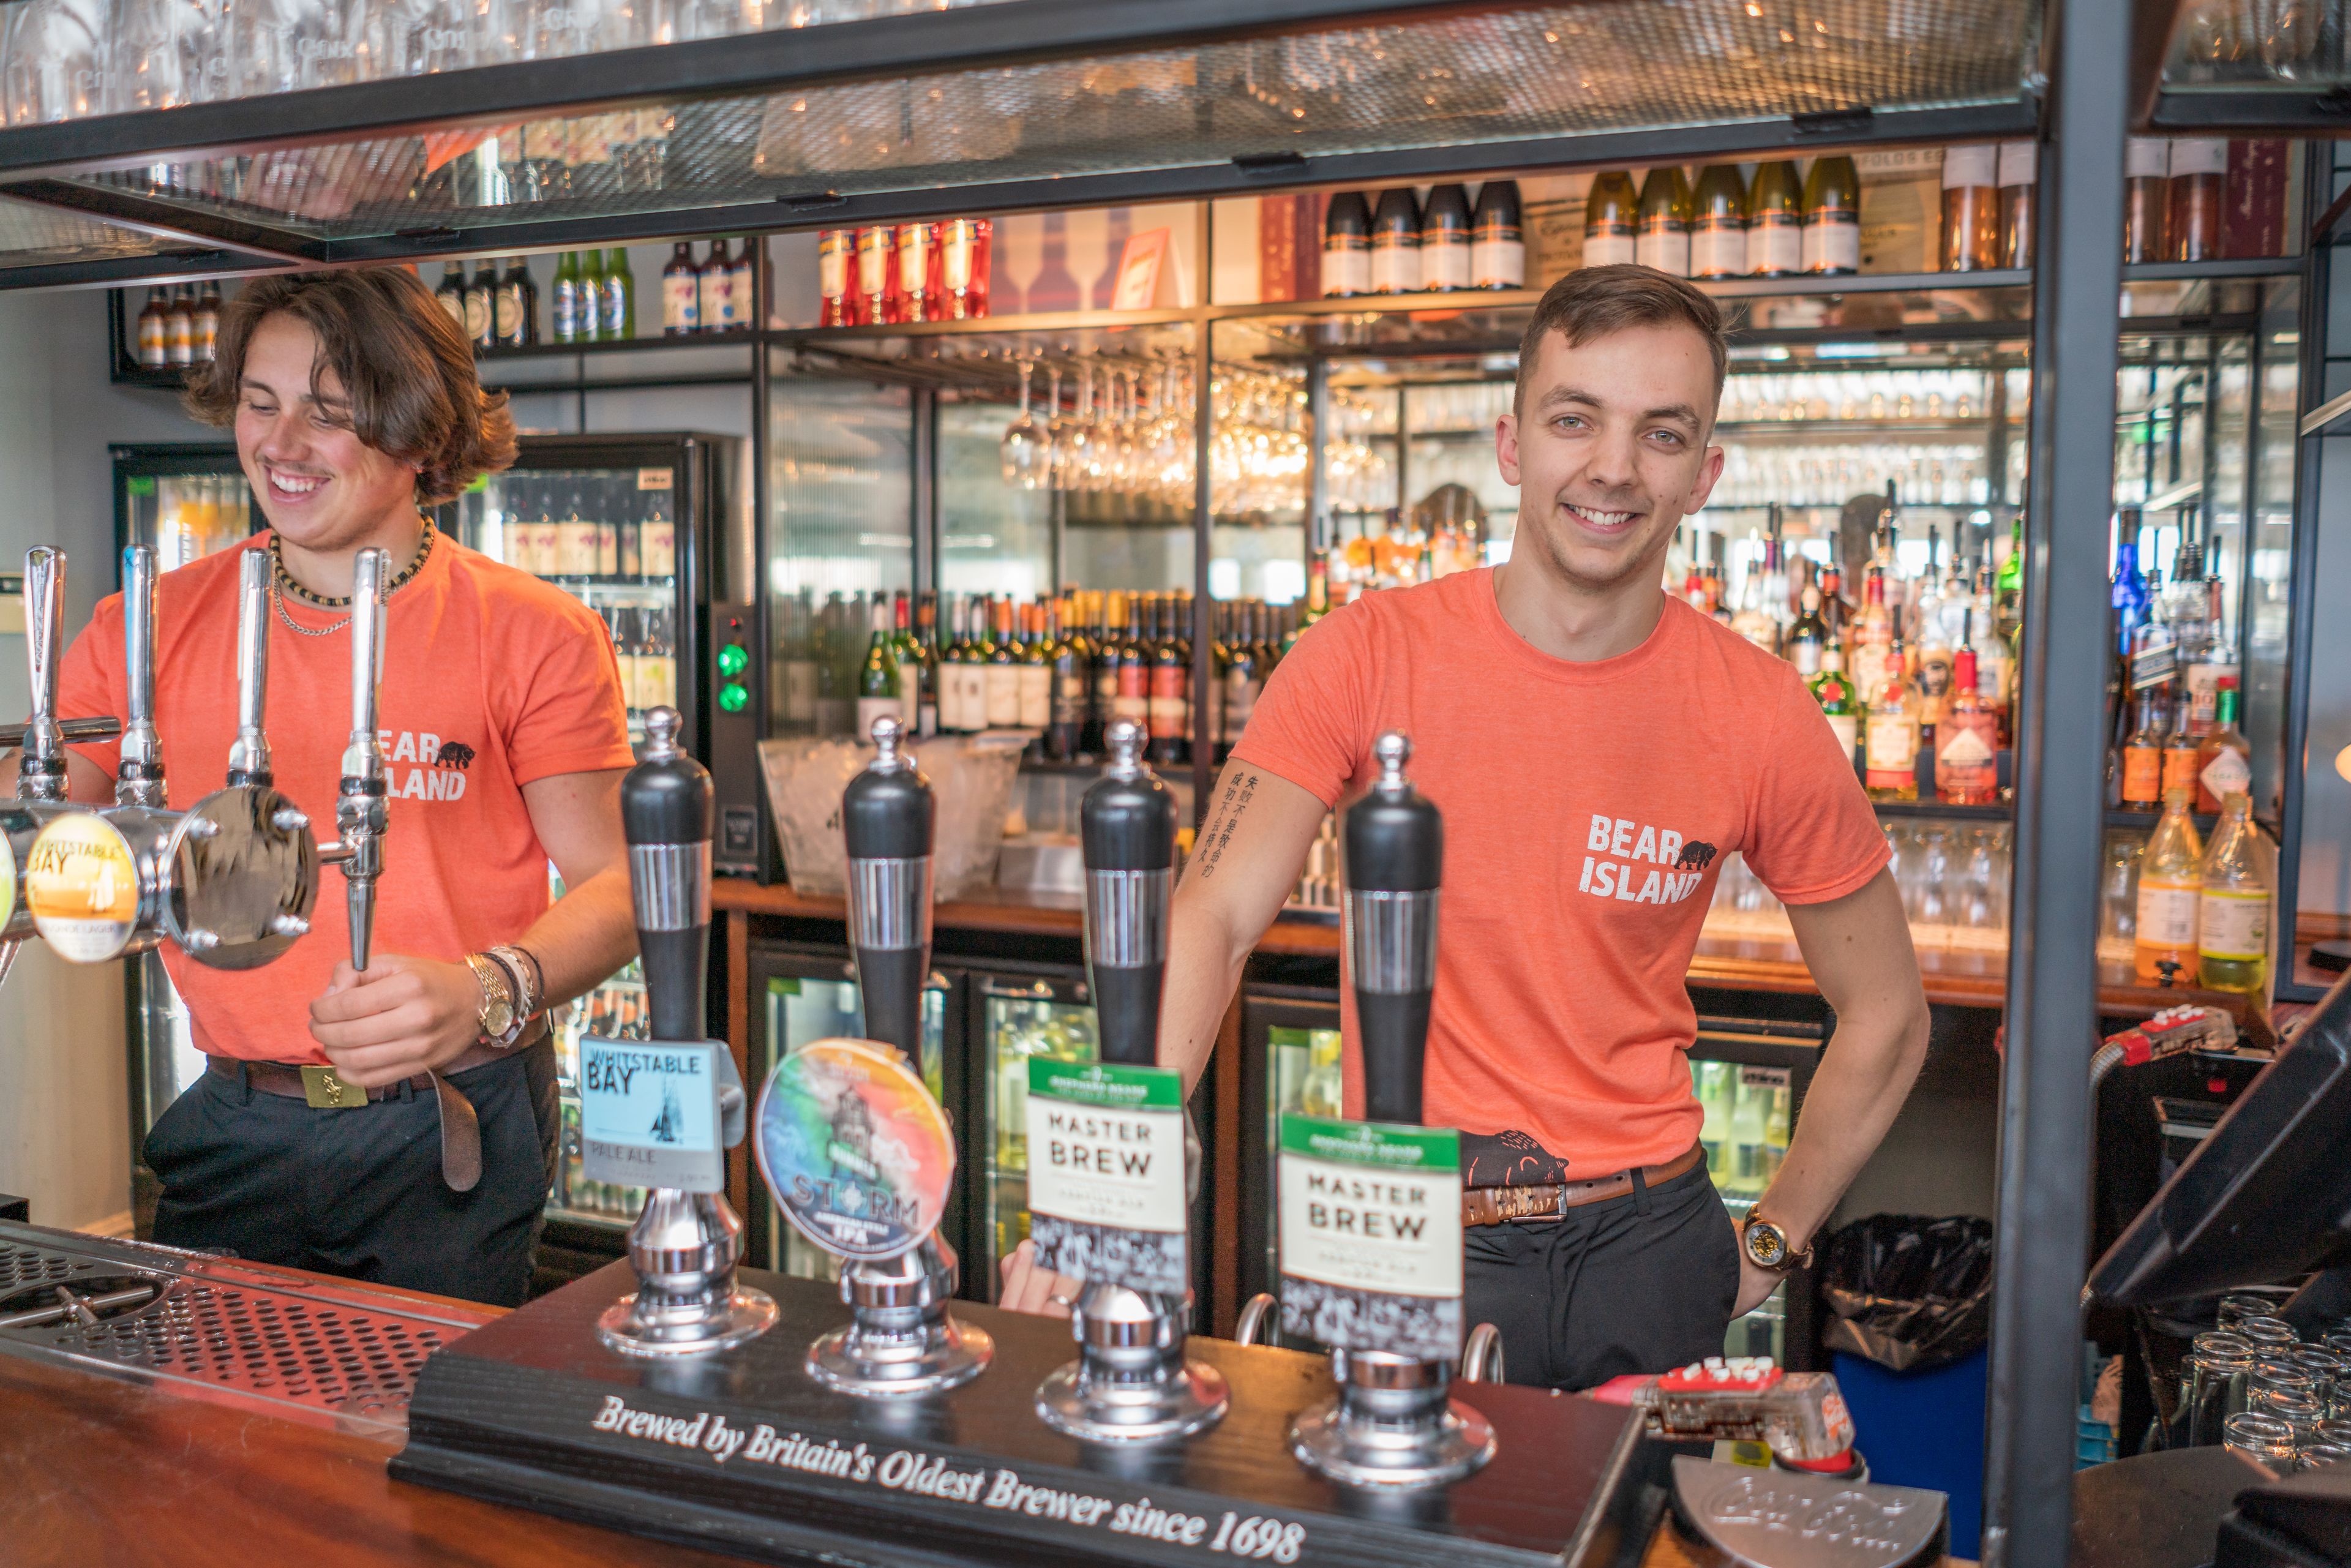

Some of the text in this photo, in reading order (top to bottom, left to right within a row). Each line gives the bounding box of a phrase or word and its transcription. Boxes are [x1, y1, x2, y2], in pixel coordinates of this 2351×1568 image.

[377, 729, 441, 763] EAR
[384, 767, 467, 801] LAND
[1587, 814, 1683, 866] BEAR
[1578, 856, 1703, 904] ISLAND
[588, 1060, 635, 1095] BAY
[591, 1048, 702, 1074] WHITSTABLE
[1049, 1112, 1151, 1141] MASTER
[592, 1142, 658, 1164] PALE ALE
[1051, 1139, 1152, 1176] BREW
[790, 1174, 921, 1230] STORM
[1308, 1173, 1427, 1205] MASTER
[1309, 1201, 1427, 1240] BREW
[593, 1395, 1307, 1564] Brewed by Britain's Oldest Brewer since 1698
